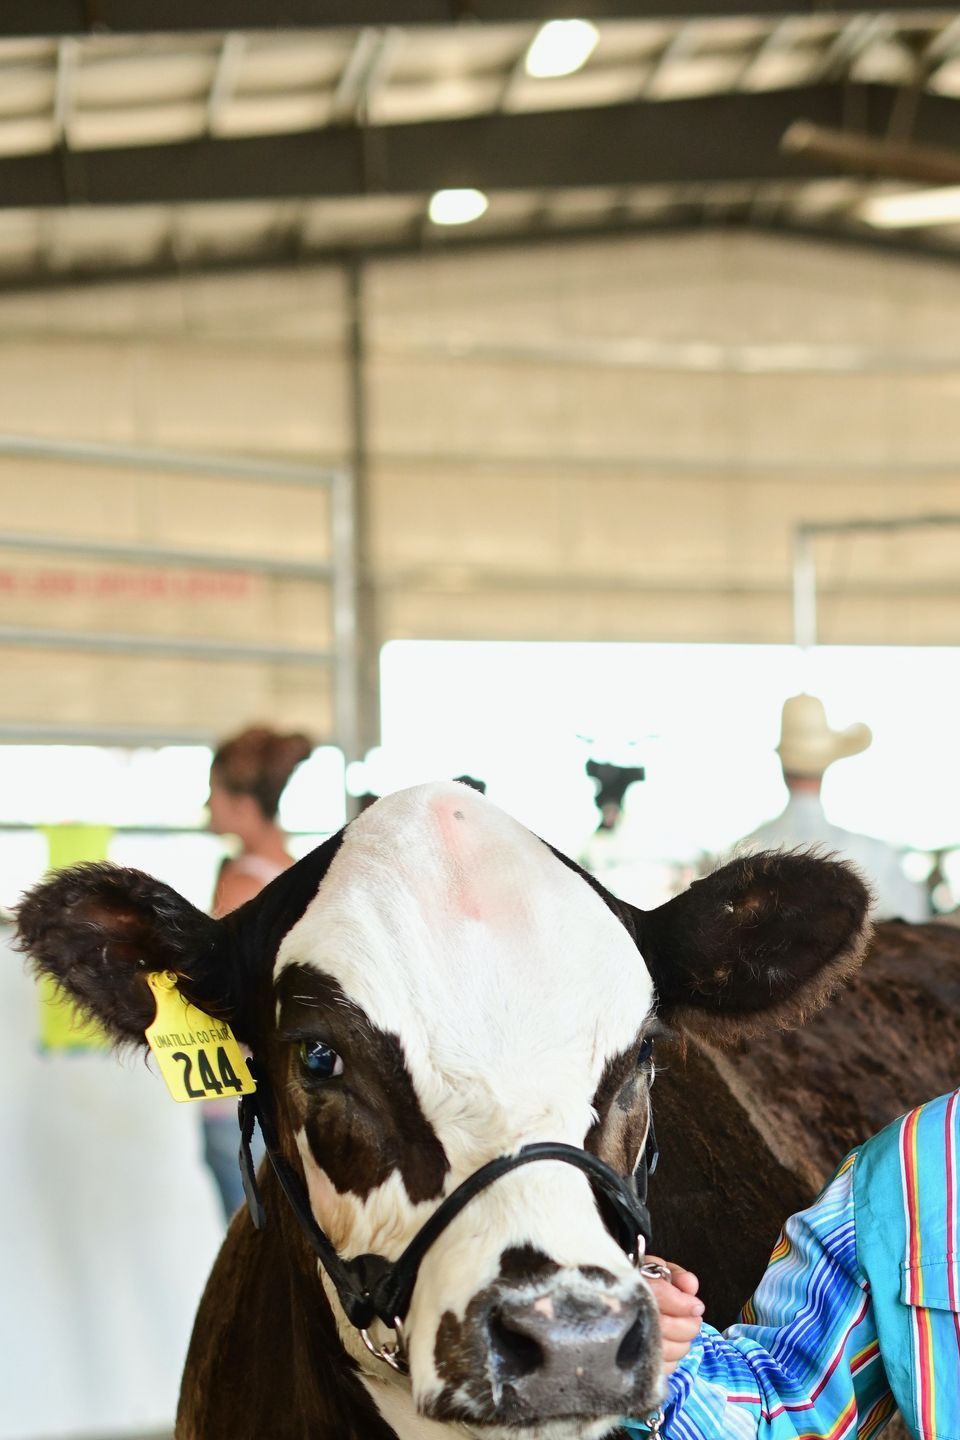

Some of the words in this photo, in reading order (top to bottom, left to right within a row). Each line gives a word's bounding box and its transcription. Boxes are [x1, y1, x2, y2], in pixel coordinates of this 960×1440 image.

[153, 1034, 196, 1049] UMATILLA
[196, 1031, 210, 1043] CO
[210, 1027, 232, 1042] FAIR
[172, 1047, 243, 1098] 244
